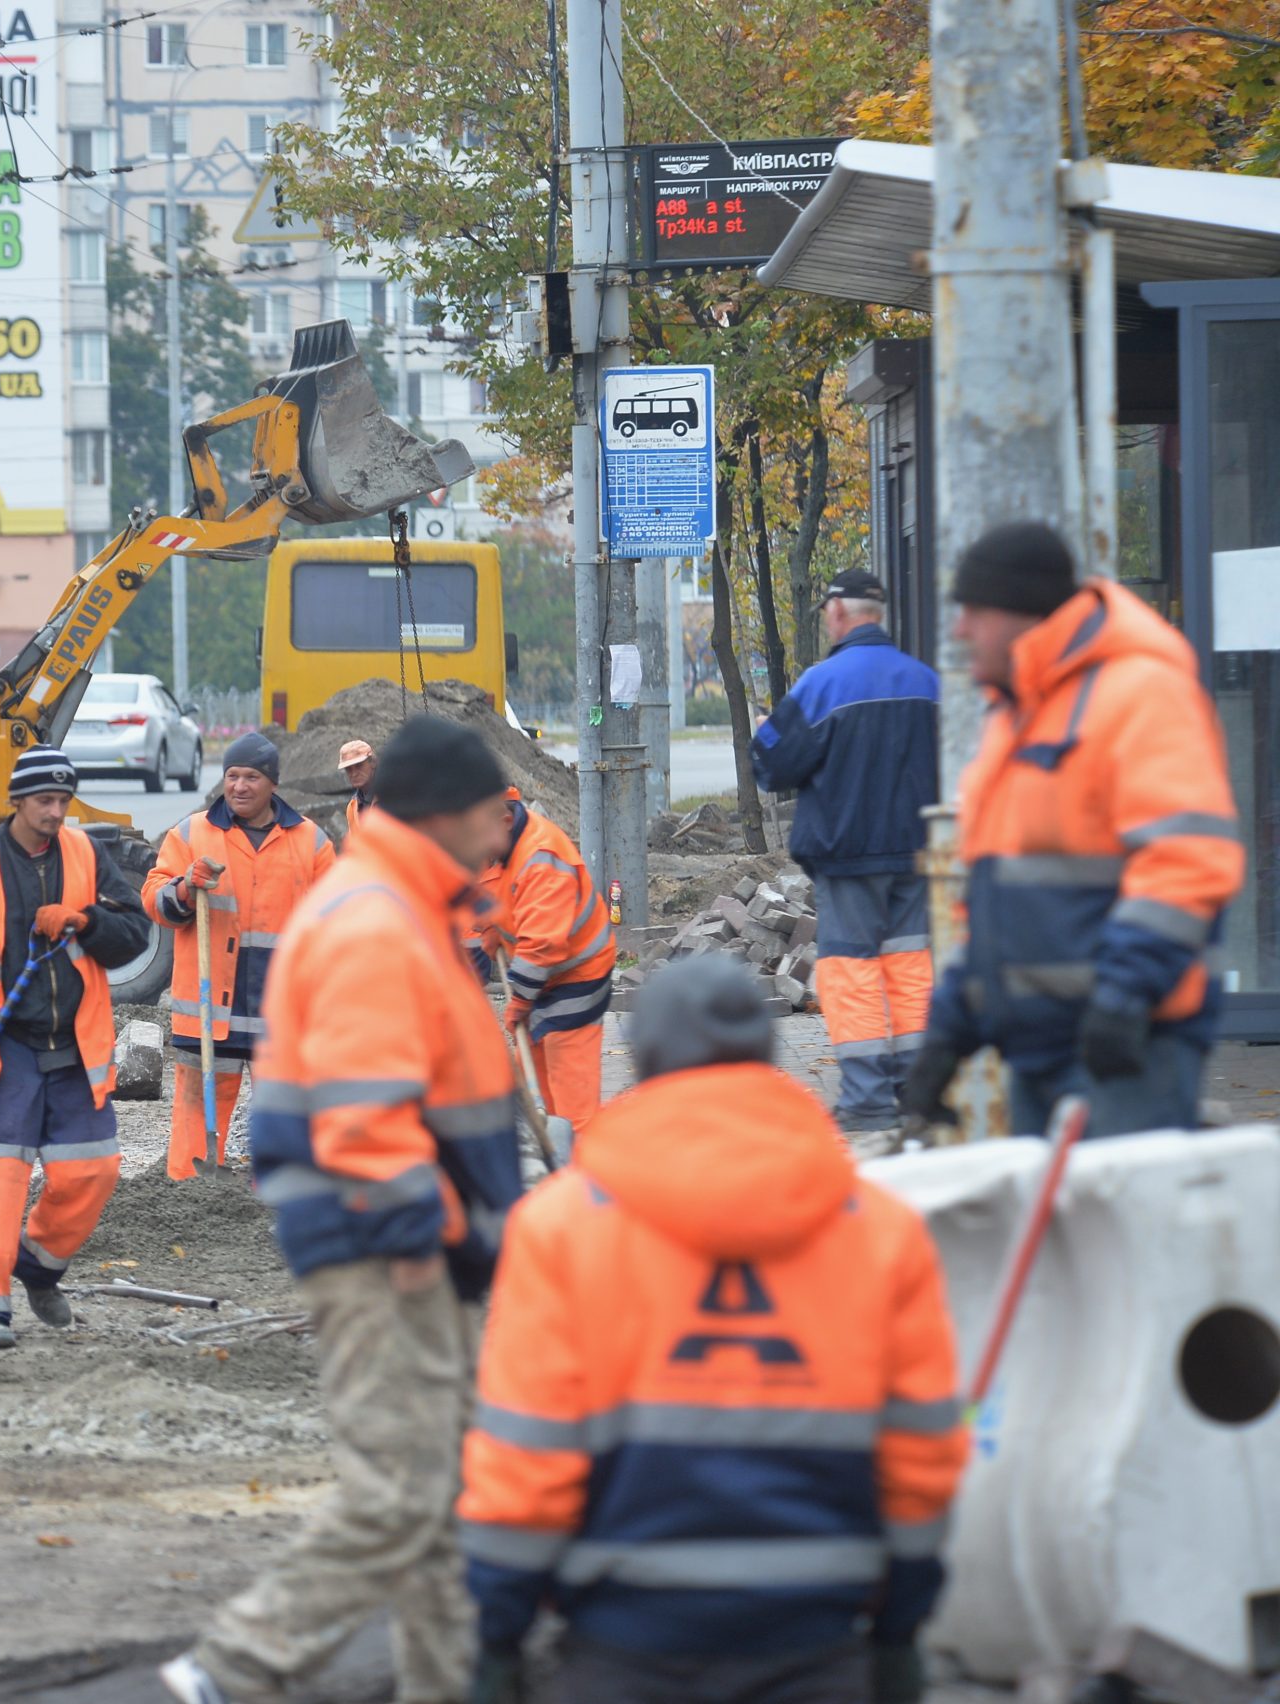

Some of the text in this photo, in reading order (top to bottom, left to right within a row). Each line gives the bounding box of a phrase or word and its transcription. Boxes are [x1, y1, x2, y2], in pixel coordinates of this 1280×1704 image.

[659, 186, 701, 196] МАРШРУТ
[726, 179, 822, 194] НАПРЯМОК РУХУ
[57, 584, 114, 665] PAUS
